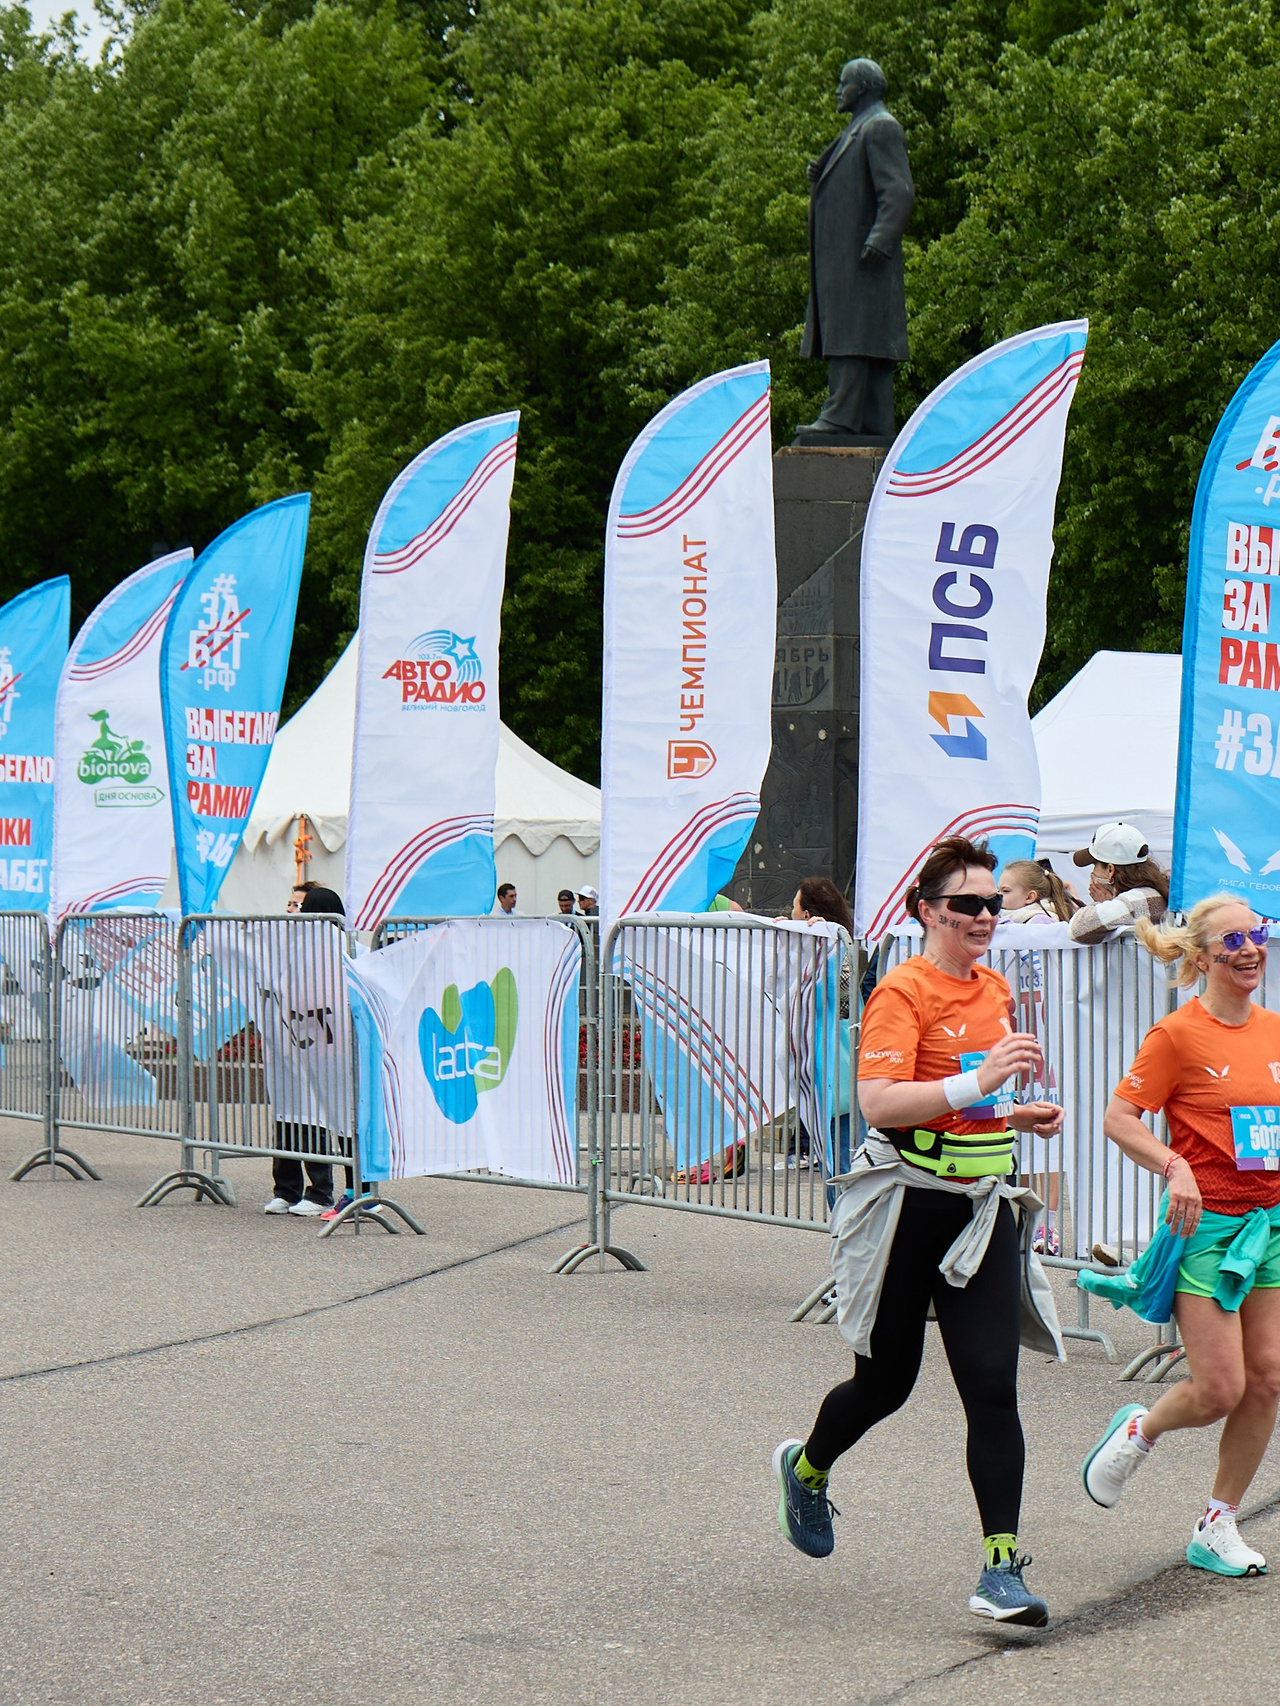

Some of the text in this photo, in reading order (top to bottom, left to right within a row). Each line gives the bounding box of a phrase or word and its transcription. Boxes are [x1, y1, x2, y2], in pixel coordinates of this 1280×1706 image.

[929, 521, 999, 675] ПСБ
[1222, 578, 1271, 635] ЗА
[679, 534, 707, 732] ЧЕМПИОНАТ
[381, 660, 452, 681] АВТО
[402, 681, 486, 703] РАДИО
[185, 706, 280, 745] ВЫБЕГАЮ
[78, 757, 151, 777] bionova
[186, 743, 217, 779] ЗА
[187, 779, 253, 818] РАМКИ
[1217, 878, 1246, 889] ЛИГА
[432, 1025, 501, 1081] lacta
